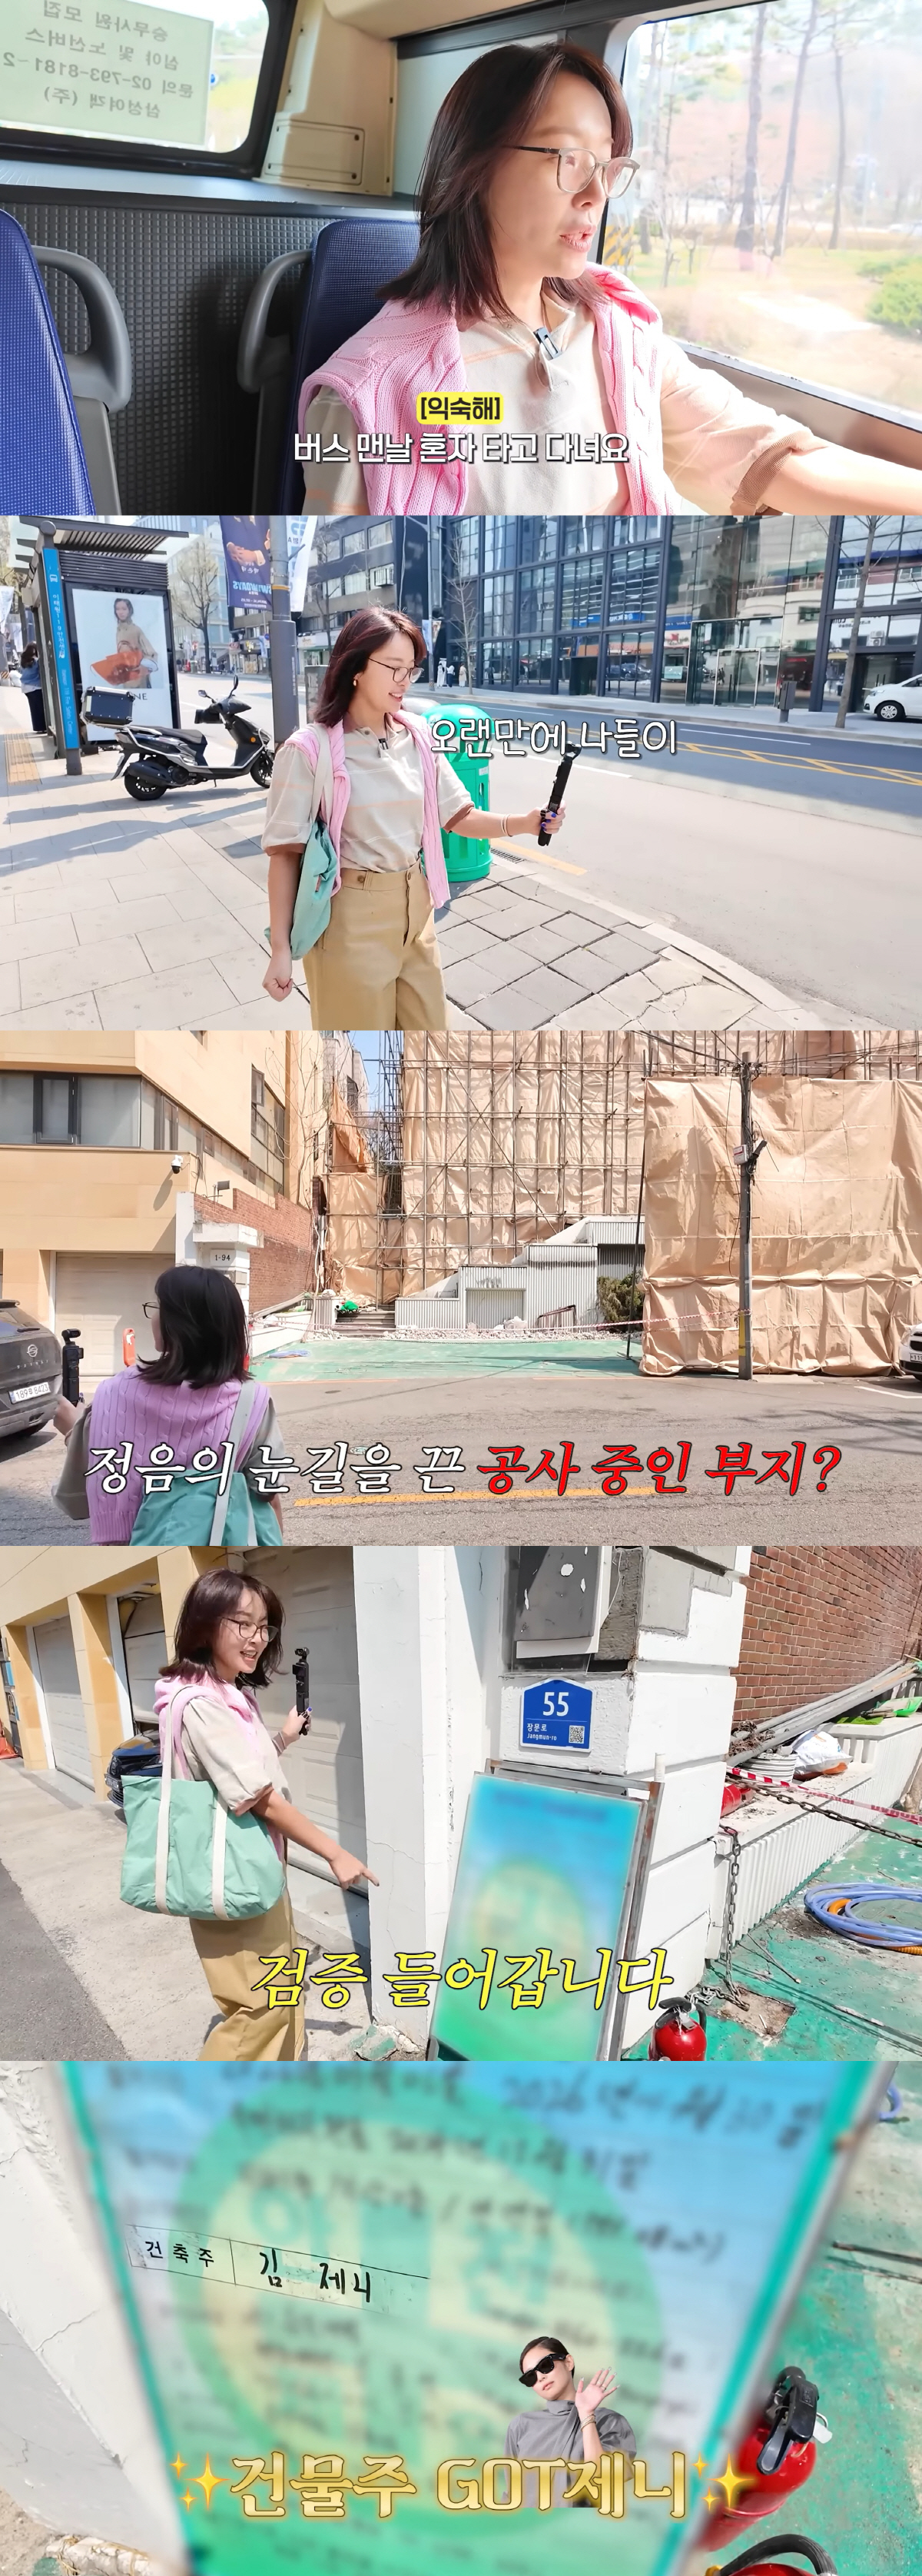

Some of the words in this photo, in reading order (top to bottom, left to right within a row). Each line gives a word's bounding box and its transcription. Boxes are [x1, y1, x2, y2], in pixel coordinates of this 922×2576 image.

[542, 1692, 569, 1717] 55
[527, 1723, 547, 1732] 장문로
[260, 2249, 283, 2288] 김
[319, 2263, 370, 2302] 제니
